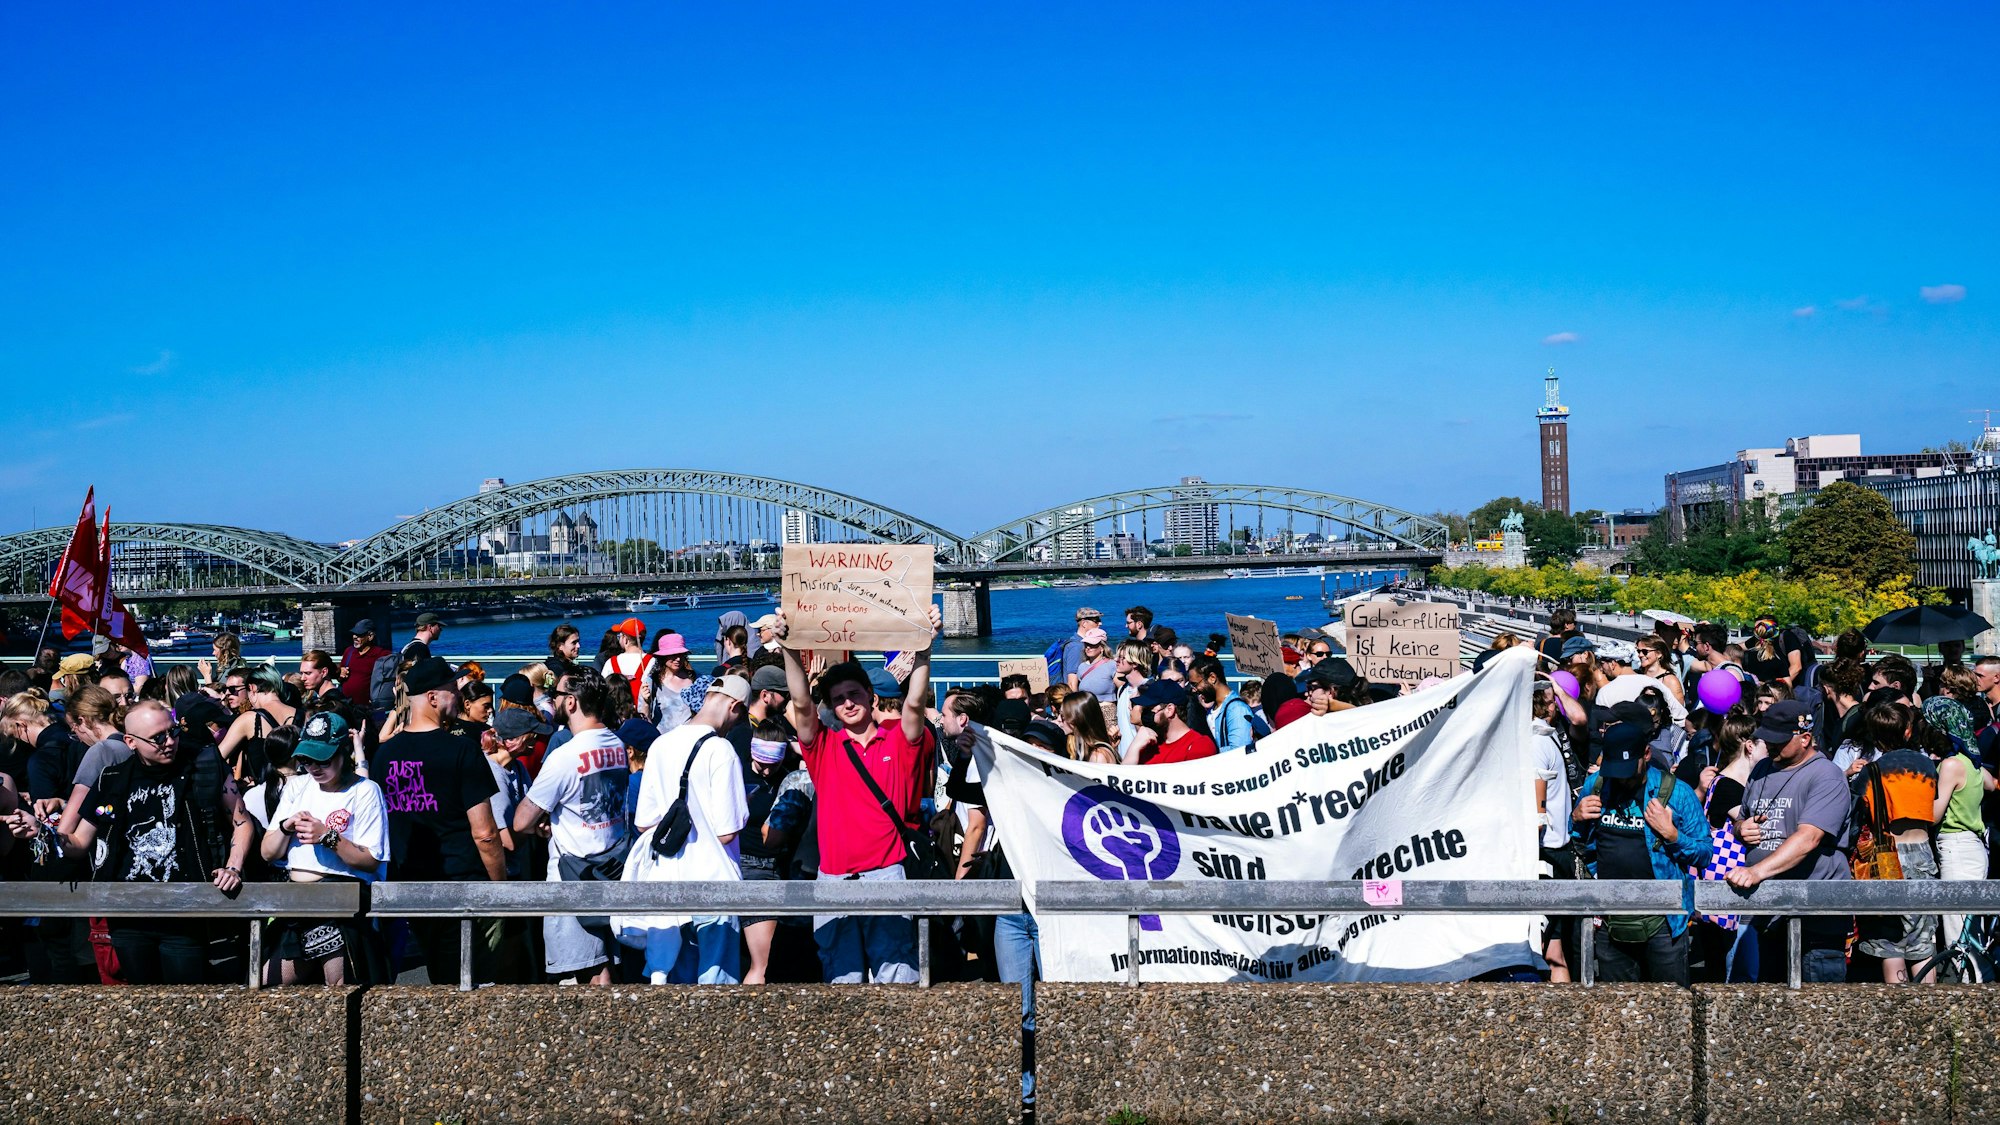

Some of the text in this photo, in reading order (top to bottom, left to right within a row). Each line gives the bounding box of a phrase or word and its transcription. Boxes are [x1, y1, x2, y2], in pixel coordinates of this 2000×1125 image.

[809, 550, 893, 571] WARNING
[826, 602, 869, 614] abortions
[815, 619, 856, 643] Safe
[1356, 634, 1440, 656] ist keine
[1021, 662, 1042, 674] body
[1107, 694, 1459, 796] Recht auf sexuelle Selbstbestimmg
[389, 760, 424, 778] JUST
[385, 775, 427, 795] SLAM
[1192, 847, 1266, 880] sind
[1268, 958, 1295, 980] für
[1297, 946, 1336, 972] alle,
